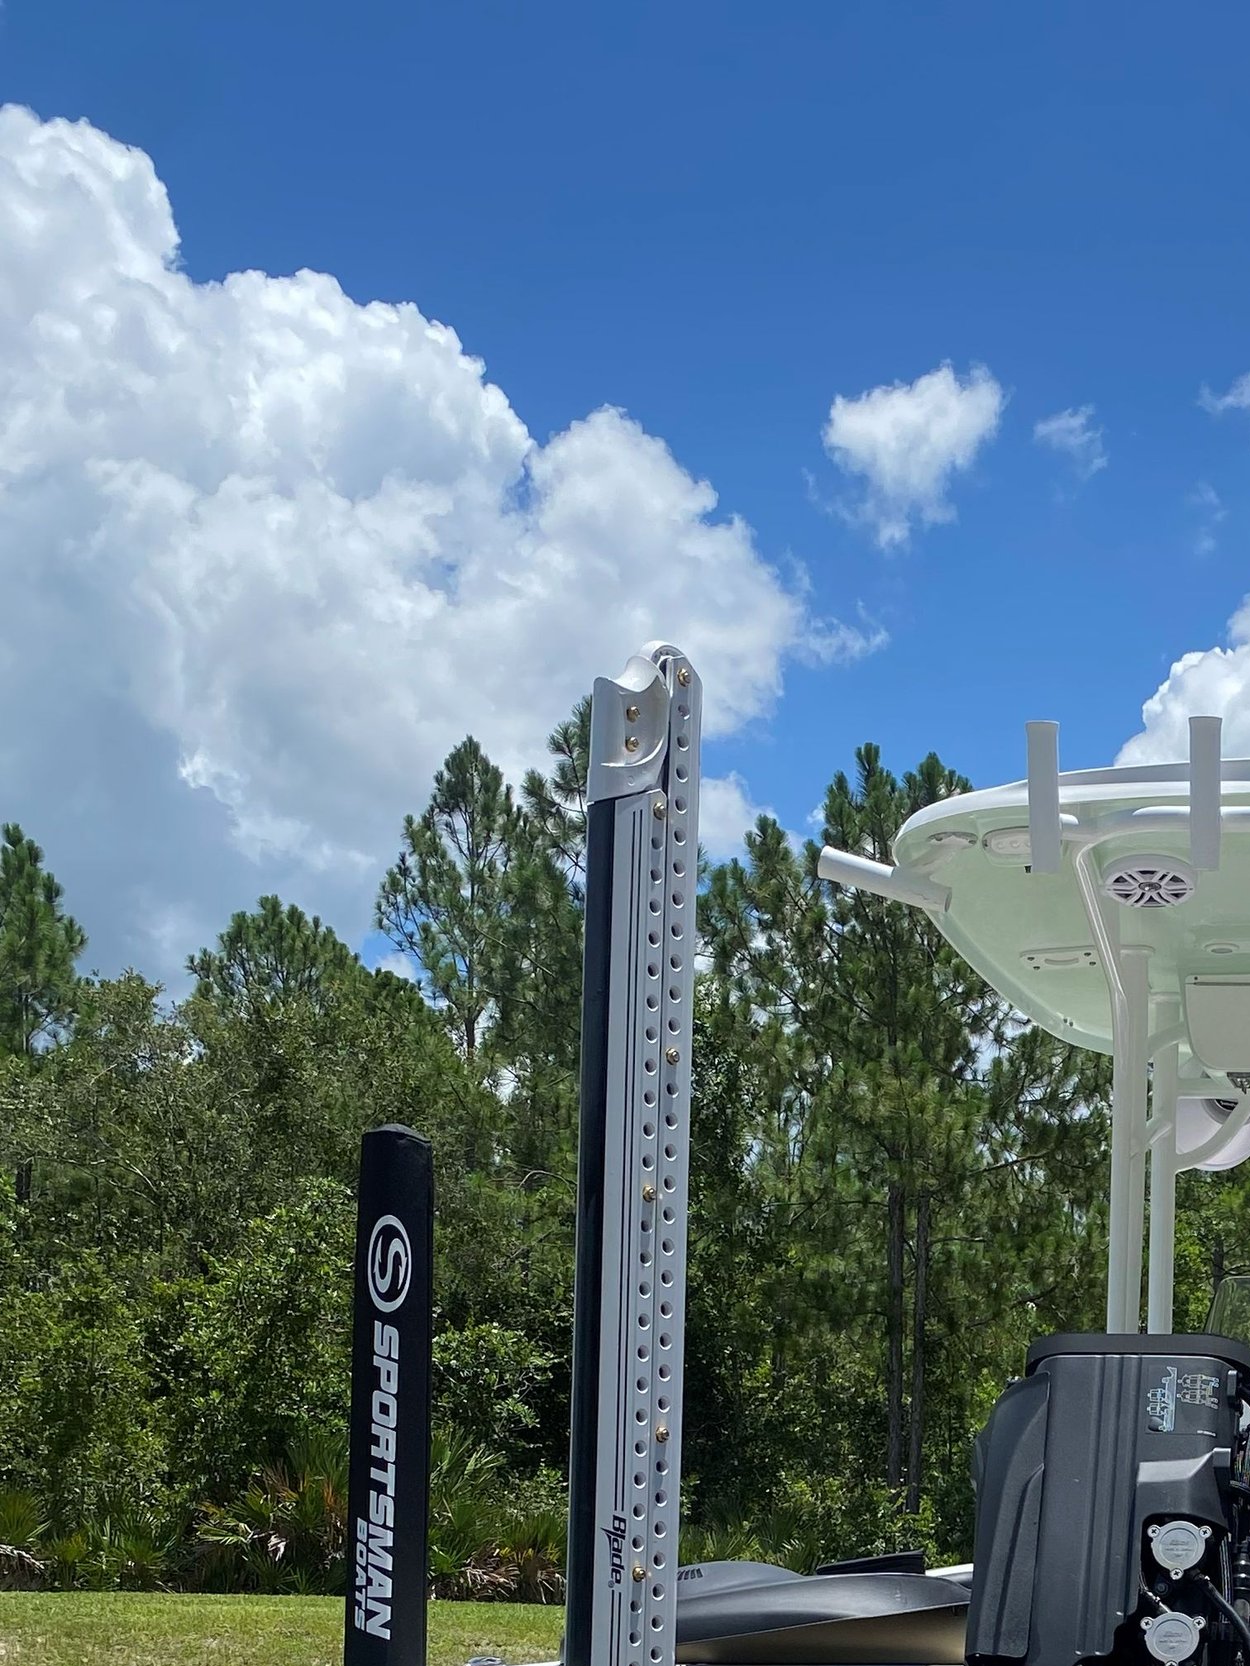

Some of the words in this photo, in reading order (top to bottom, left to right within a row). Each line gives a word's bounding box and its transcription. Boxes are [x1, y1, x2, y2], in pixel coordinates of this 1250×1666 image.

[365, 1319, 400, 1641] SPORTSMAN
[354, 1516, 368, 1631] BOATS
[600, 1514, 627, 1585] Blade
